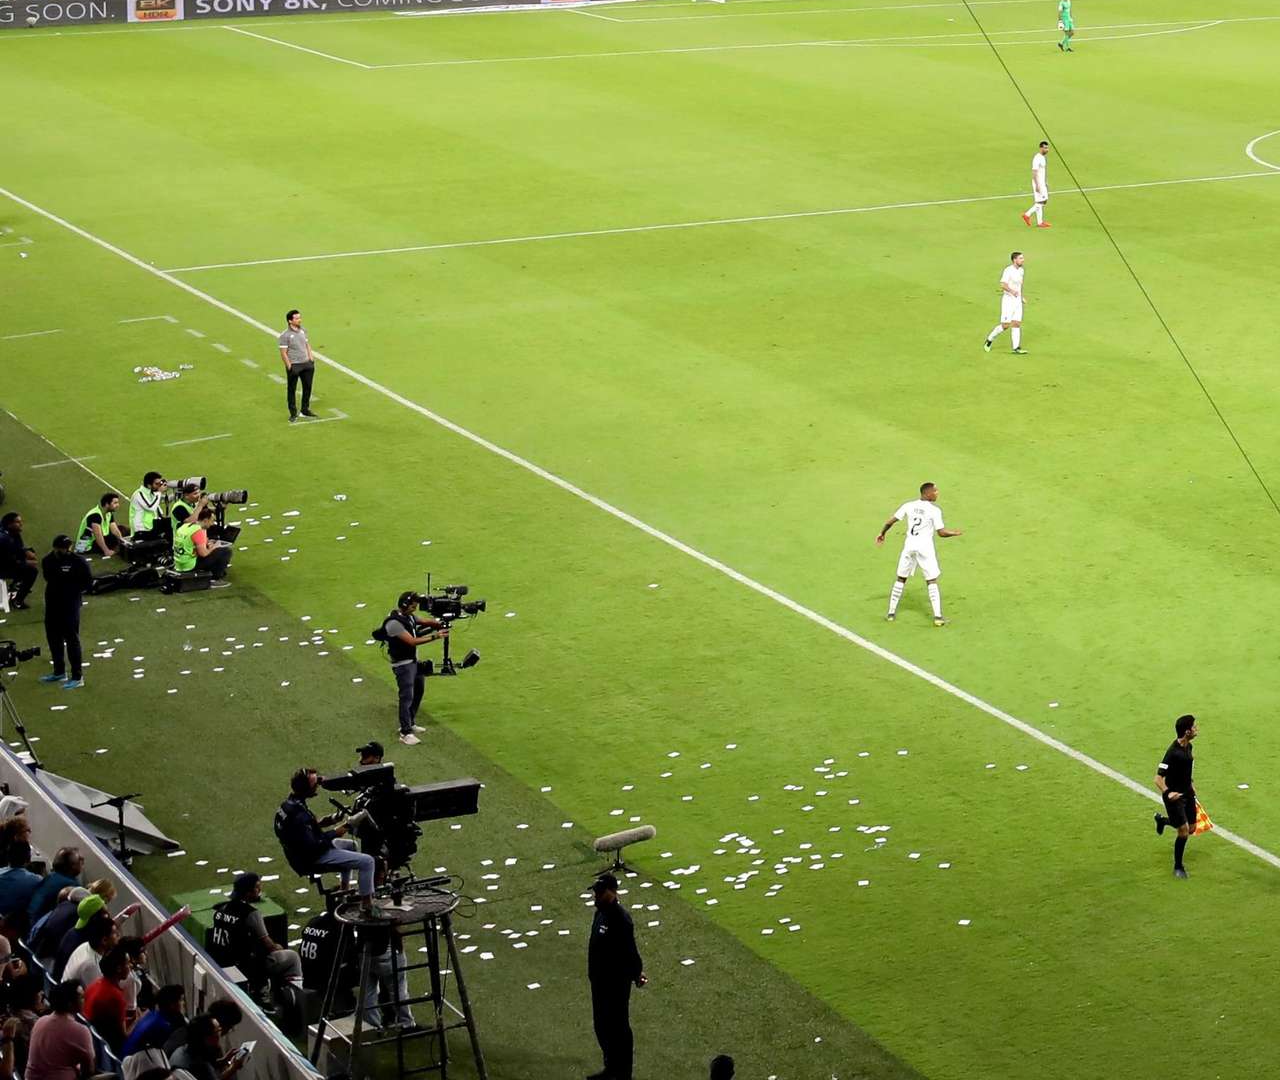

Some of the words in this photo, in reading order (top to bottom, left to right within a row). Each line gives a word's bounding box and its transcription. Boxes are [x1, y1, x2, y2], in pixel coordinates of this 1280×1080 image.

[910, 517, 922, 536] 2
[304, 926, 329, 938] SONY
[300, 942, 318, 960] HB
